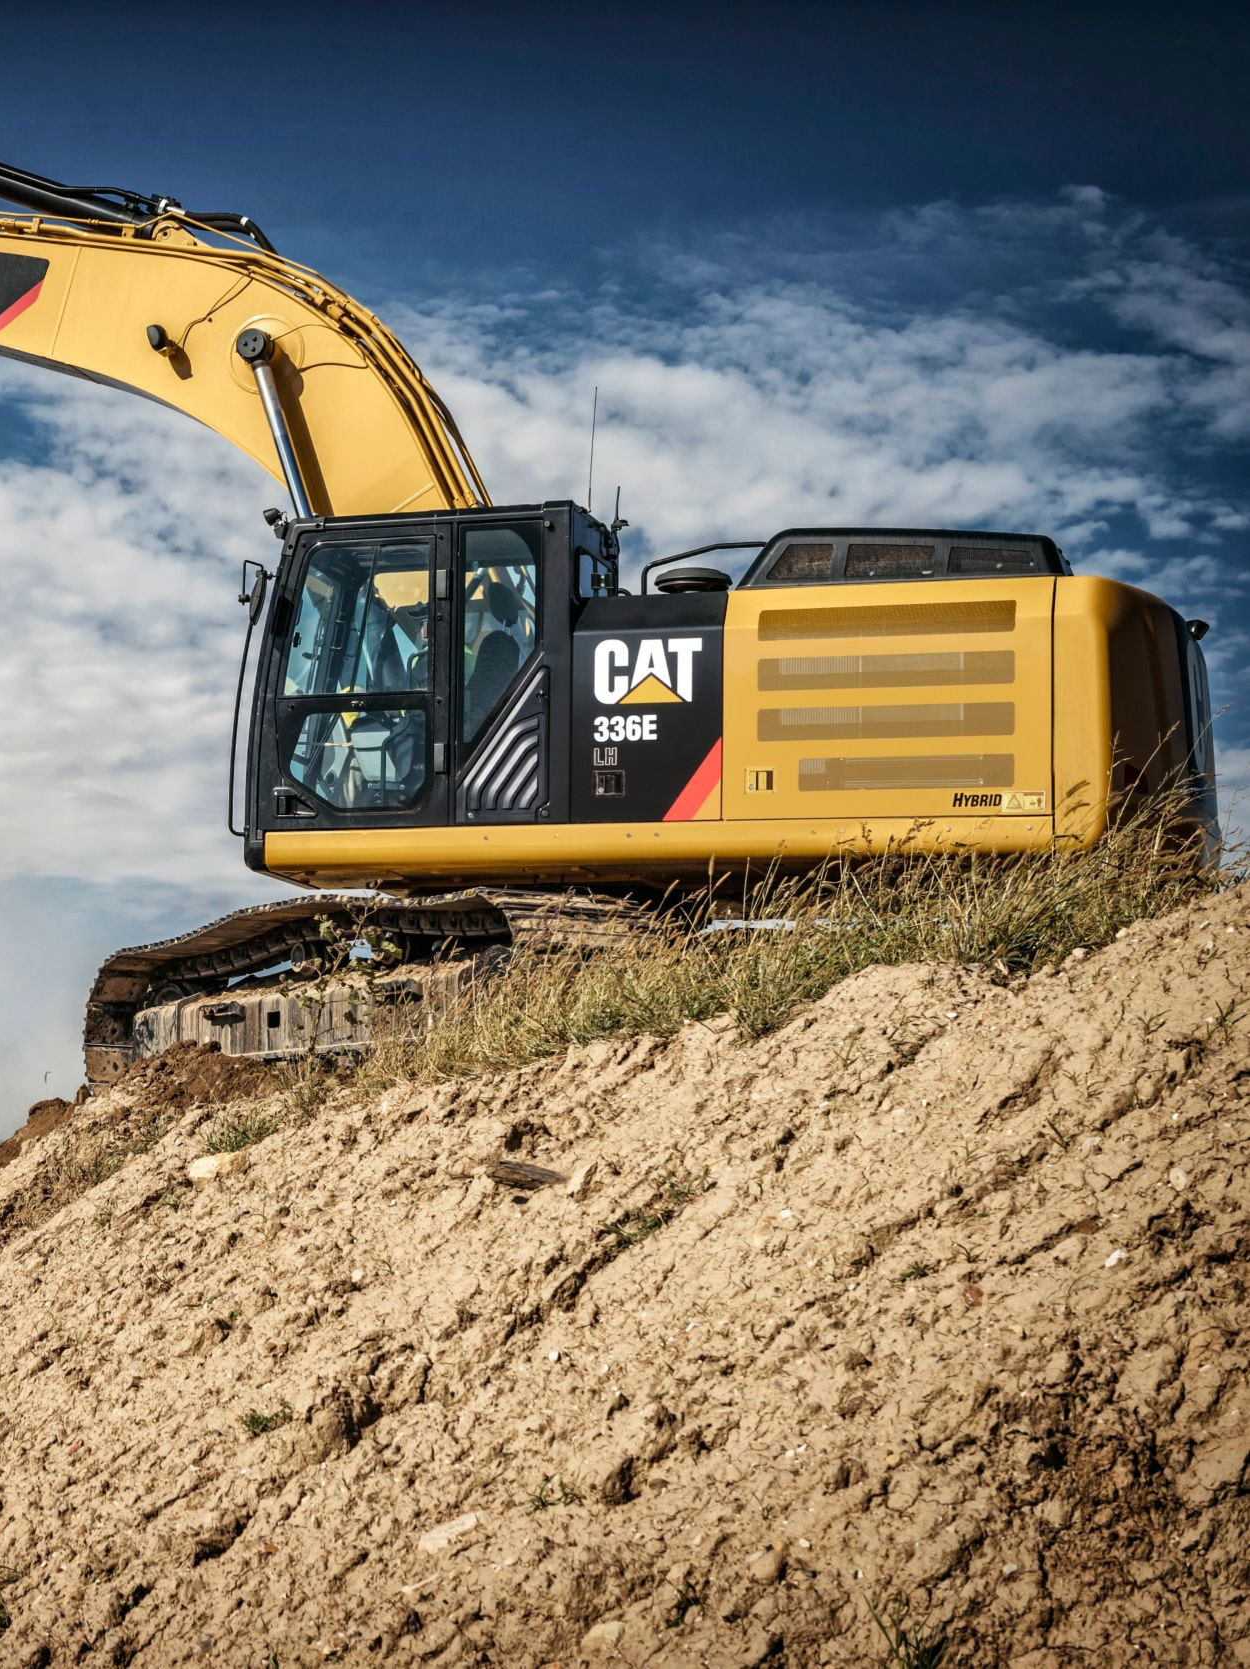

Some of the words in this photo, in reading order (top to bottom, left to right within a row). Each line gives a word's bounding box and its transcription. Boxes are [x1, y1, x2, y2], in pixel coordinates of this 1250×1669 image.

[594, 637, 703, 705] CAT
[593, 714, 658, 742] 336E
[593, 747, 618, 766] LH
[952, 792, 1002, 807] HYBRID
